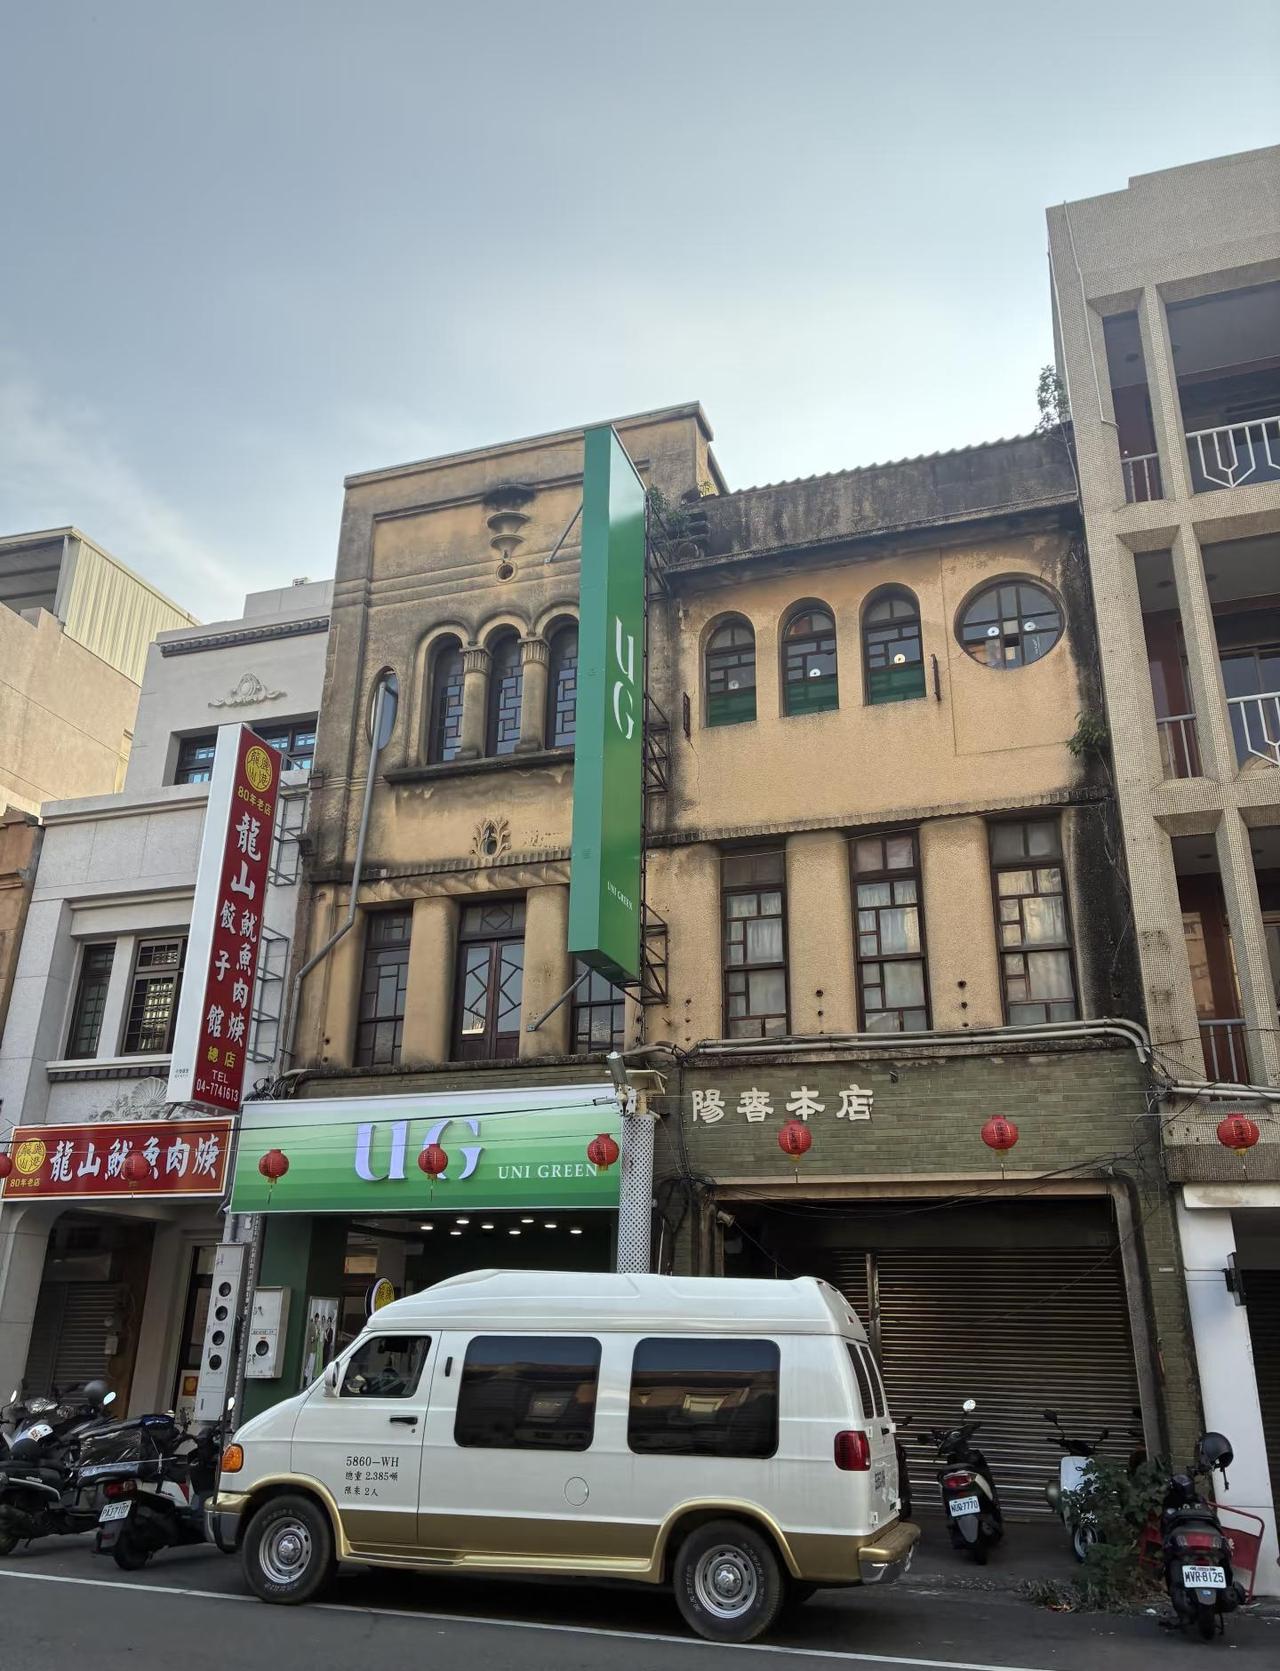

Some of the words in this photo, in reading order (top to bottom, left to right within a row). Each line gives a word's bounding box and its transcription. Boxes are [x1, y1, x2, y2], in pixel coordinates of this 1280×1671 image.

[237, 785, 272, 817] 80年老店
[230, 811, 262, 901] 龍山
[206, 898, 237, 1038] 餃子館
[211, 1069, 229, 1084] TEL
[196, 1078, 239, 1102] 04-7741613
[498, 1165, 530, 1179] UNI
[537, 1163, 598, 1178] GREEN
[345, 1455, 400, 1468] 5860-WH
